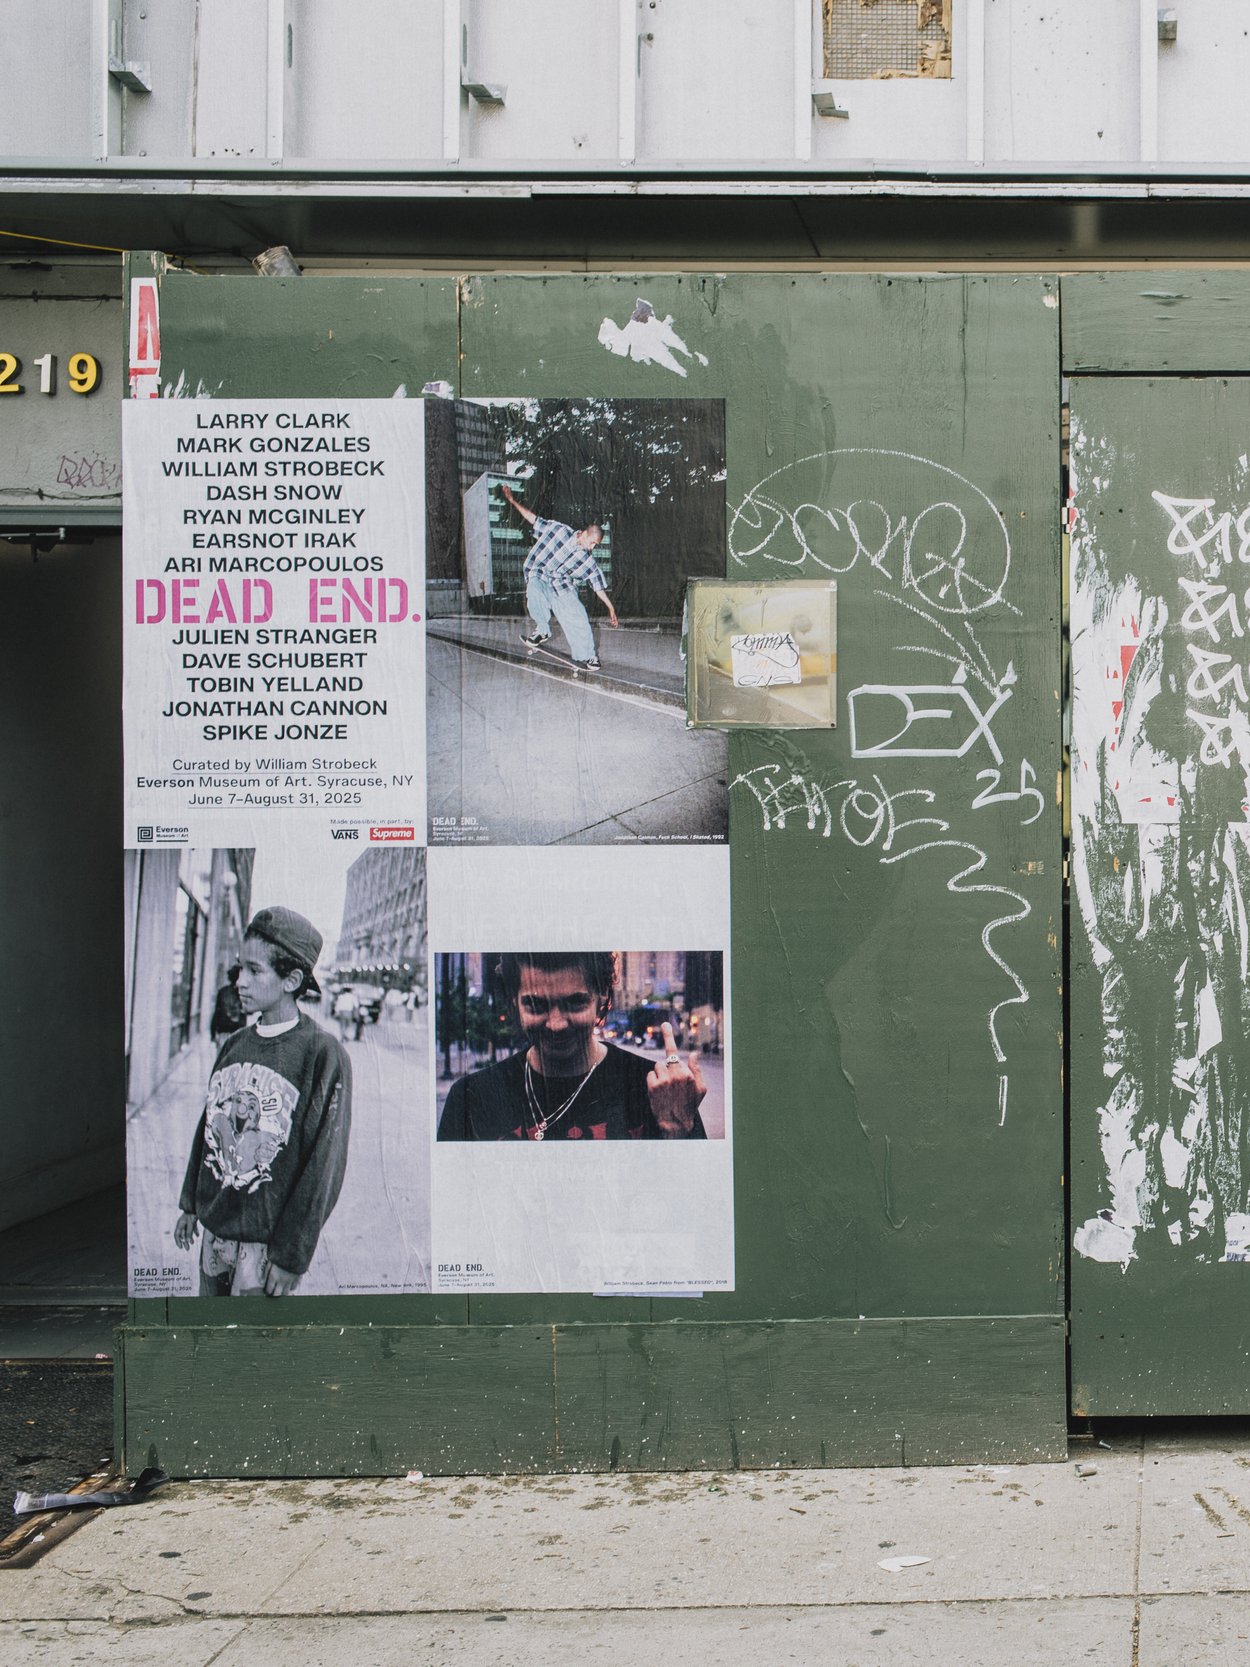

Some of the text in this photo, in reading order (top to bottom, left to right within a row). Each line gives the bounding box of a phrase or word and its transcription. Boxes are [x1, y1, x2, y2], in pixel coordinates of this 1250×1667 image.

[0, 352, 101, 394] 219
[197, 413, 350, 429] LARRY CLARK
[177, 437, 370, 453] MARK GONZALES
[162, 461, 384, 477] WILLIAM STROBECK
[207, 485, 342, 500] DASH SNOW
[184, 509, 365, 524] RYAN MCGINLEY
[193, 533, 356, 548] EARSNOT IRAK
[164, 556, 383, 572] ARI MARCOPOULOS
[135, 578, 421, 624] DEAD END.
[172, 629, 376, 645] JULIEN STRANGER
[183, 653, 367, 668] DAVE SCHUBERT
[187, 677, 363, 692] TOBIN YELLAND
[162, 700, 387, 717] JONATHAN CANNON
[203, 725, 347, 740] SPIKE JONZE
[172, 758, 378, 773] Curated by William Strobeck
[137, 775, 413, 789] Everson Museum of Art. Syracuse, NY
[188, 793, 223, 806] June
[299, 793, 320, 807] 31,
[324, 793, 362, 804] 2025
[433, 816, 479, 826] DEAD END.
[156, 826, 189, 834] Everson
[331, 828, 412, 840] VANS Supreme
[134, 1267, 181, 1276] DEAD END.
[438, 1263, 484, 1272] DEAD END.
